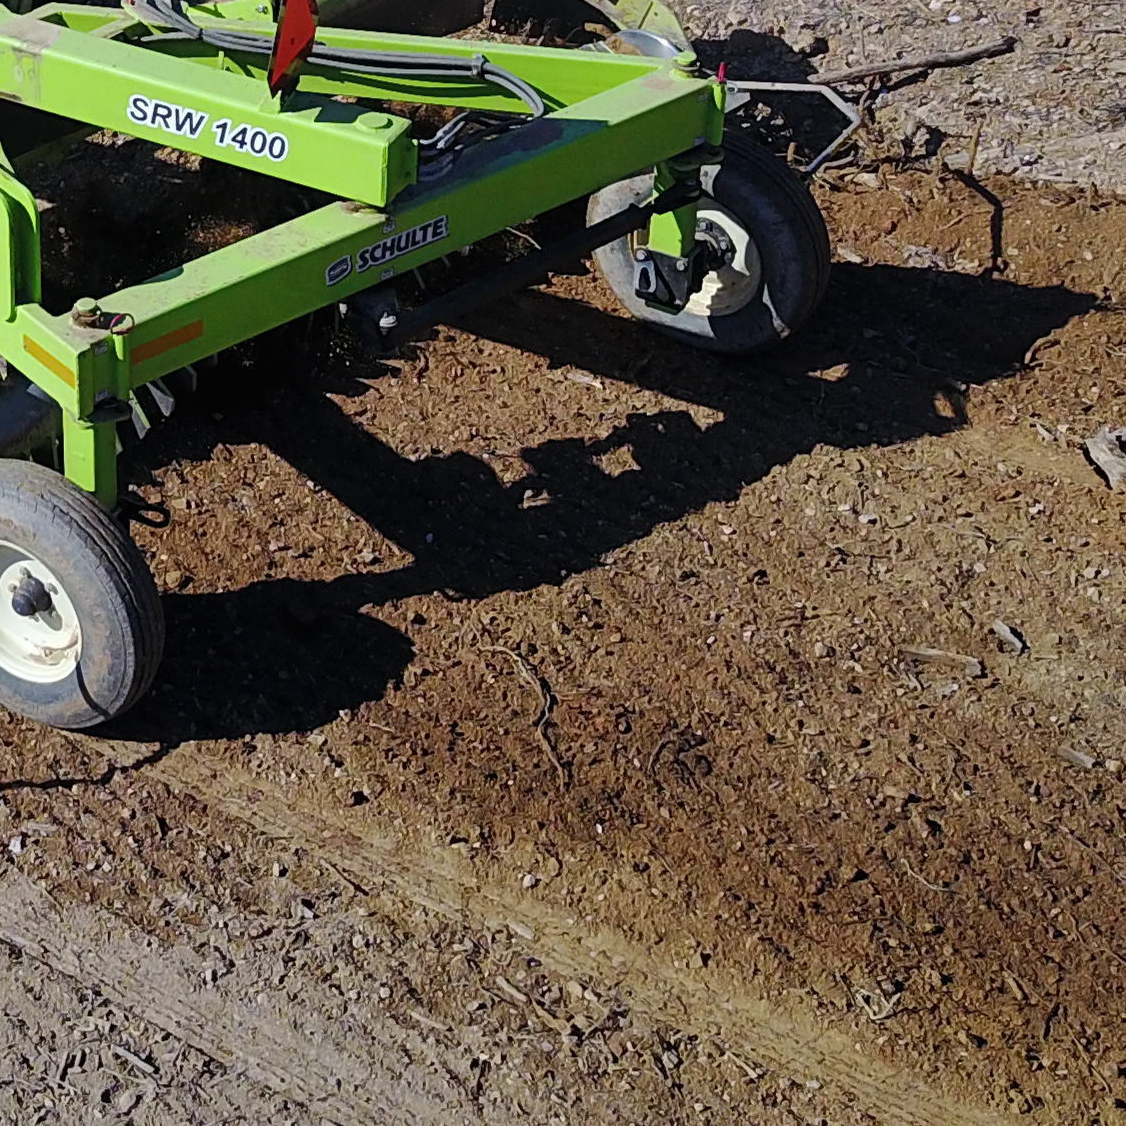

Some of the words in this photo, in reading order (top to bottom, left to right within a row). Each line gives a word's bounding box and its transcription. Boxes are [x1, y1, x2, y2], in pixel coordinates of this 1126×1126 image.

[130, 97, 206, 136] SRW
[215, 121, 286, 159] 1400
[357, 215, 446, 270] SCHULTE
